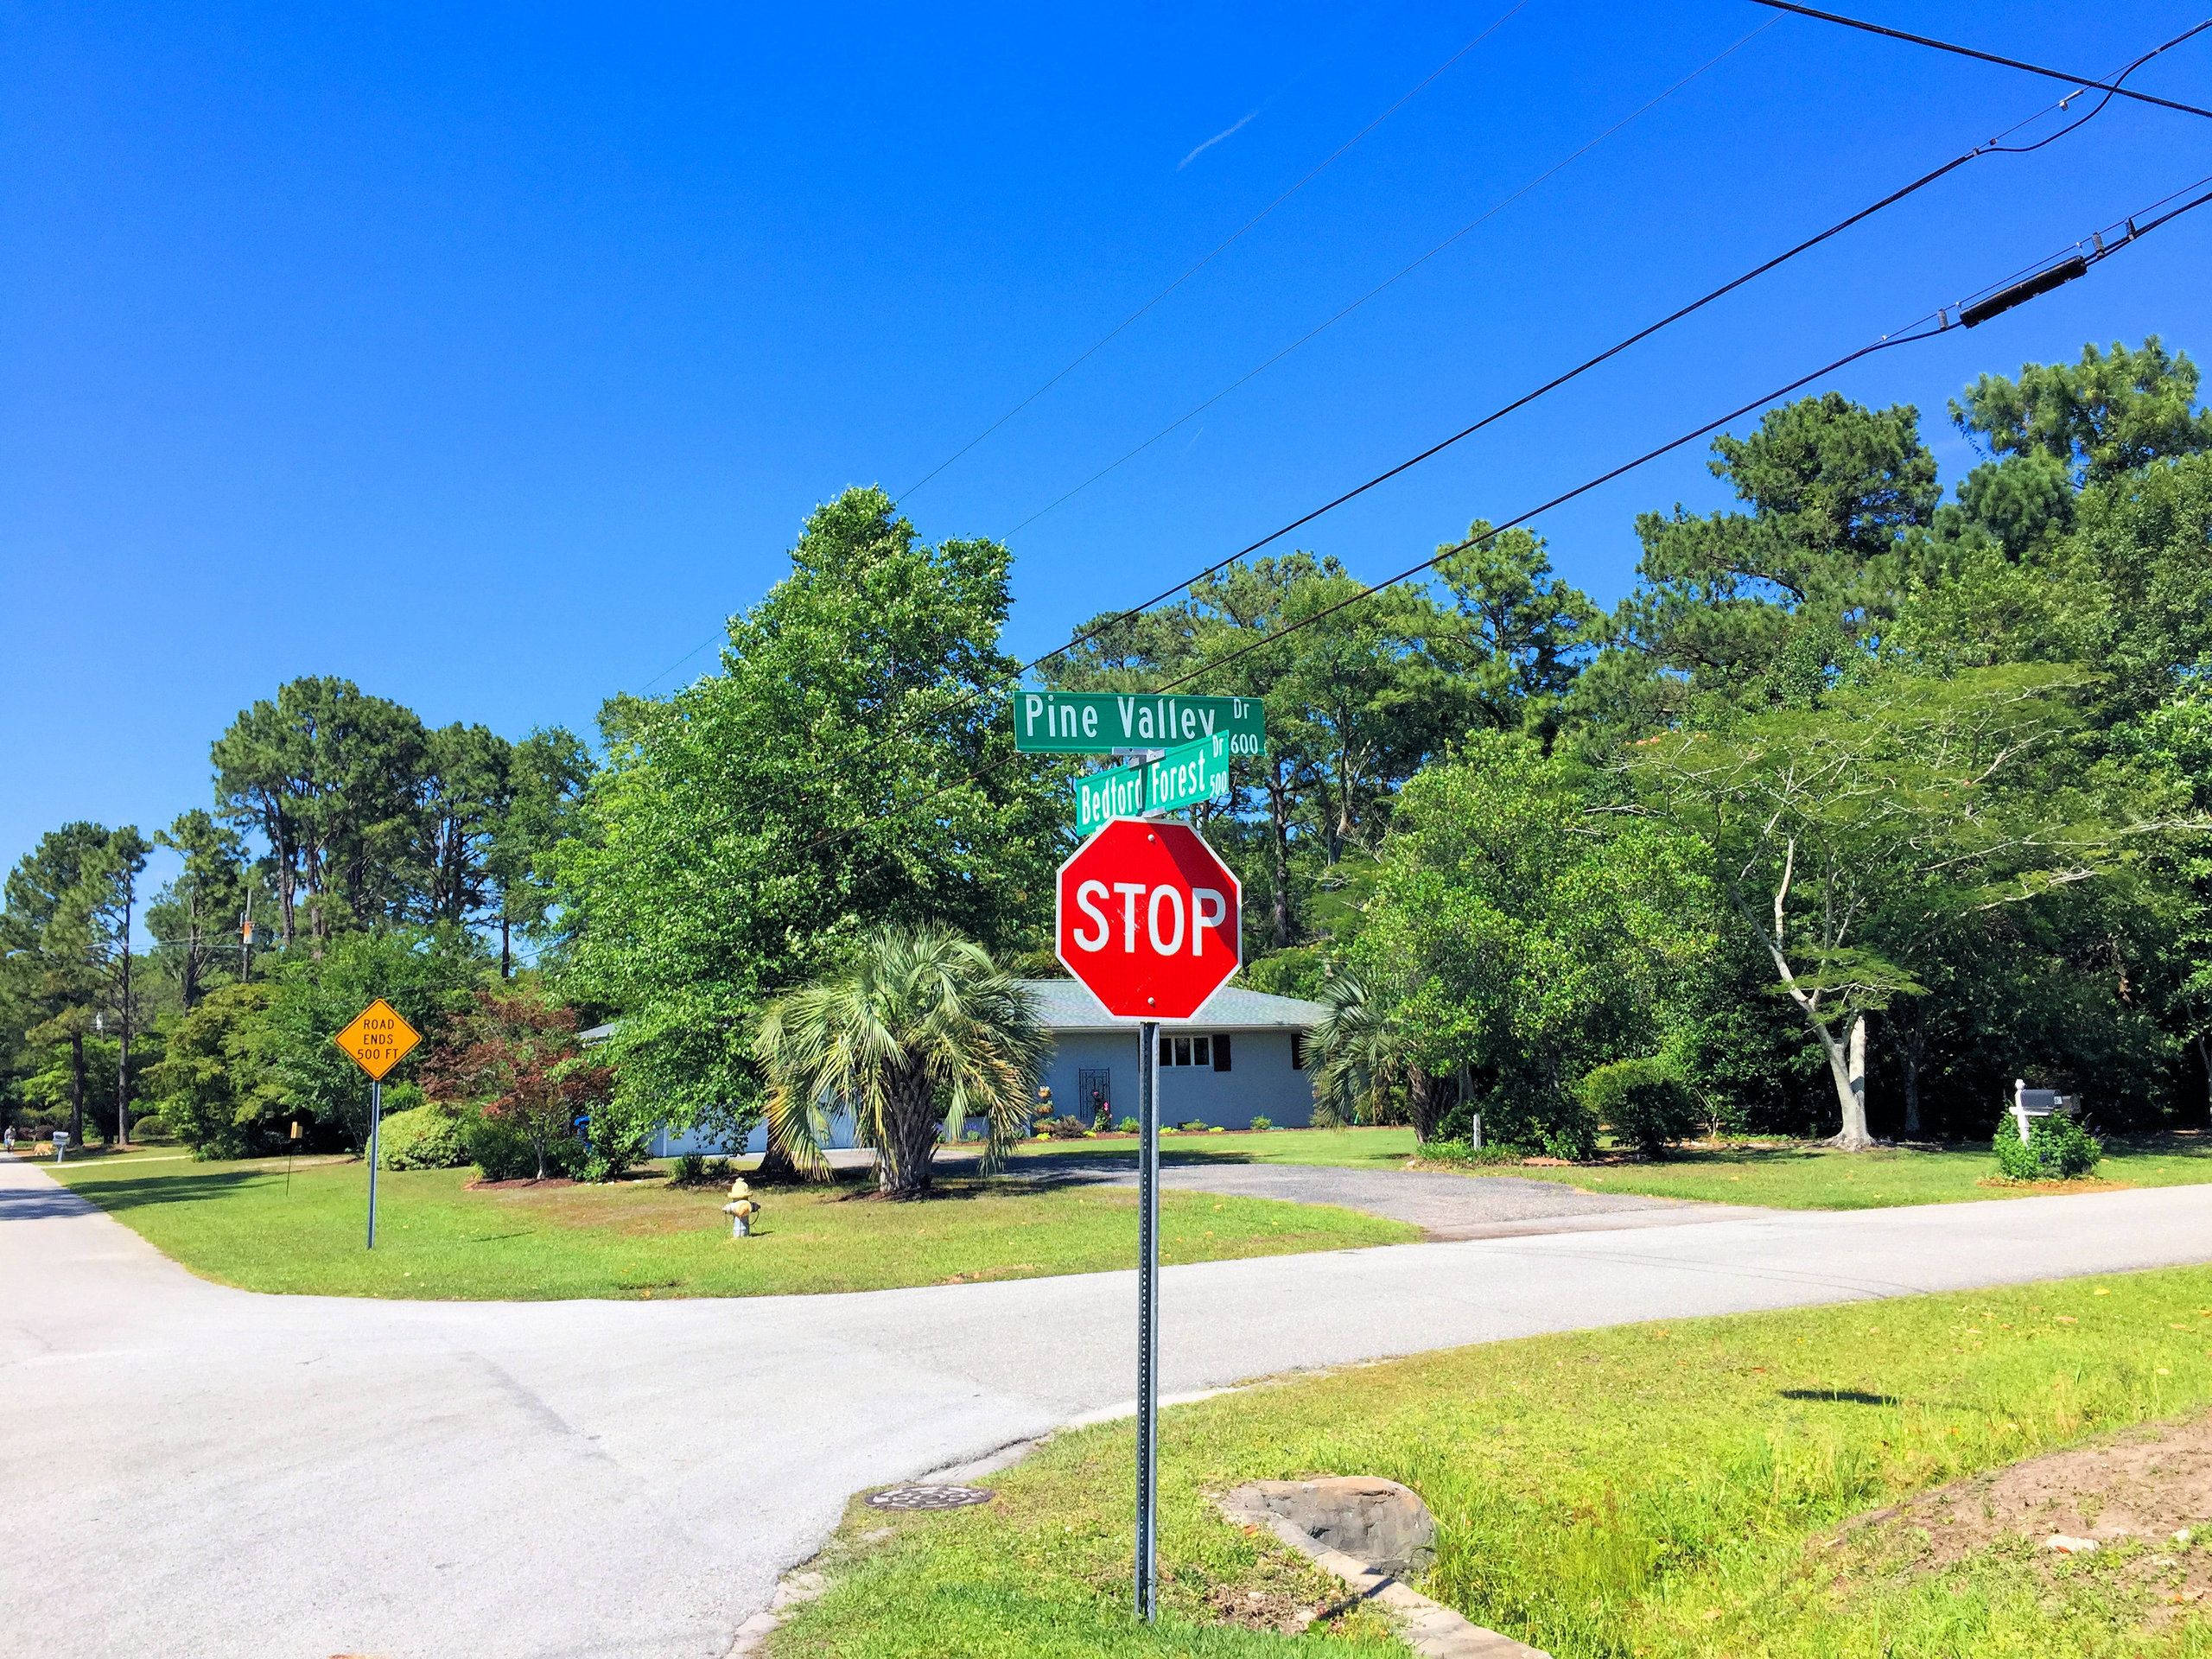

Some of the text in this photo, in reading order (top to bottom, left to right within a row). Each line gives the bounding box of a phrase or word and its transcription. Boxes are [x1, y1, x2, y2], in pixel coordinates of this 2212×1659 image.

[1025, 694, 1249, 741] Pine Valley Dr
[1230, 734, 1258, 754] 600
[1082, 734, 1224, 824] Bedford Forest Dr
[1210, 770, 1227, 797] 500
[1073, 880, 1226, 957] STOP
[363, 1019, 395, 1030] ROAD
[363, 1034, 393, 1045] ENDS
[357, 1049, 398, 1060] 500 FT
